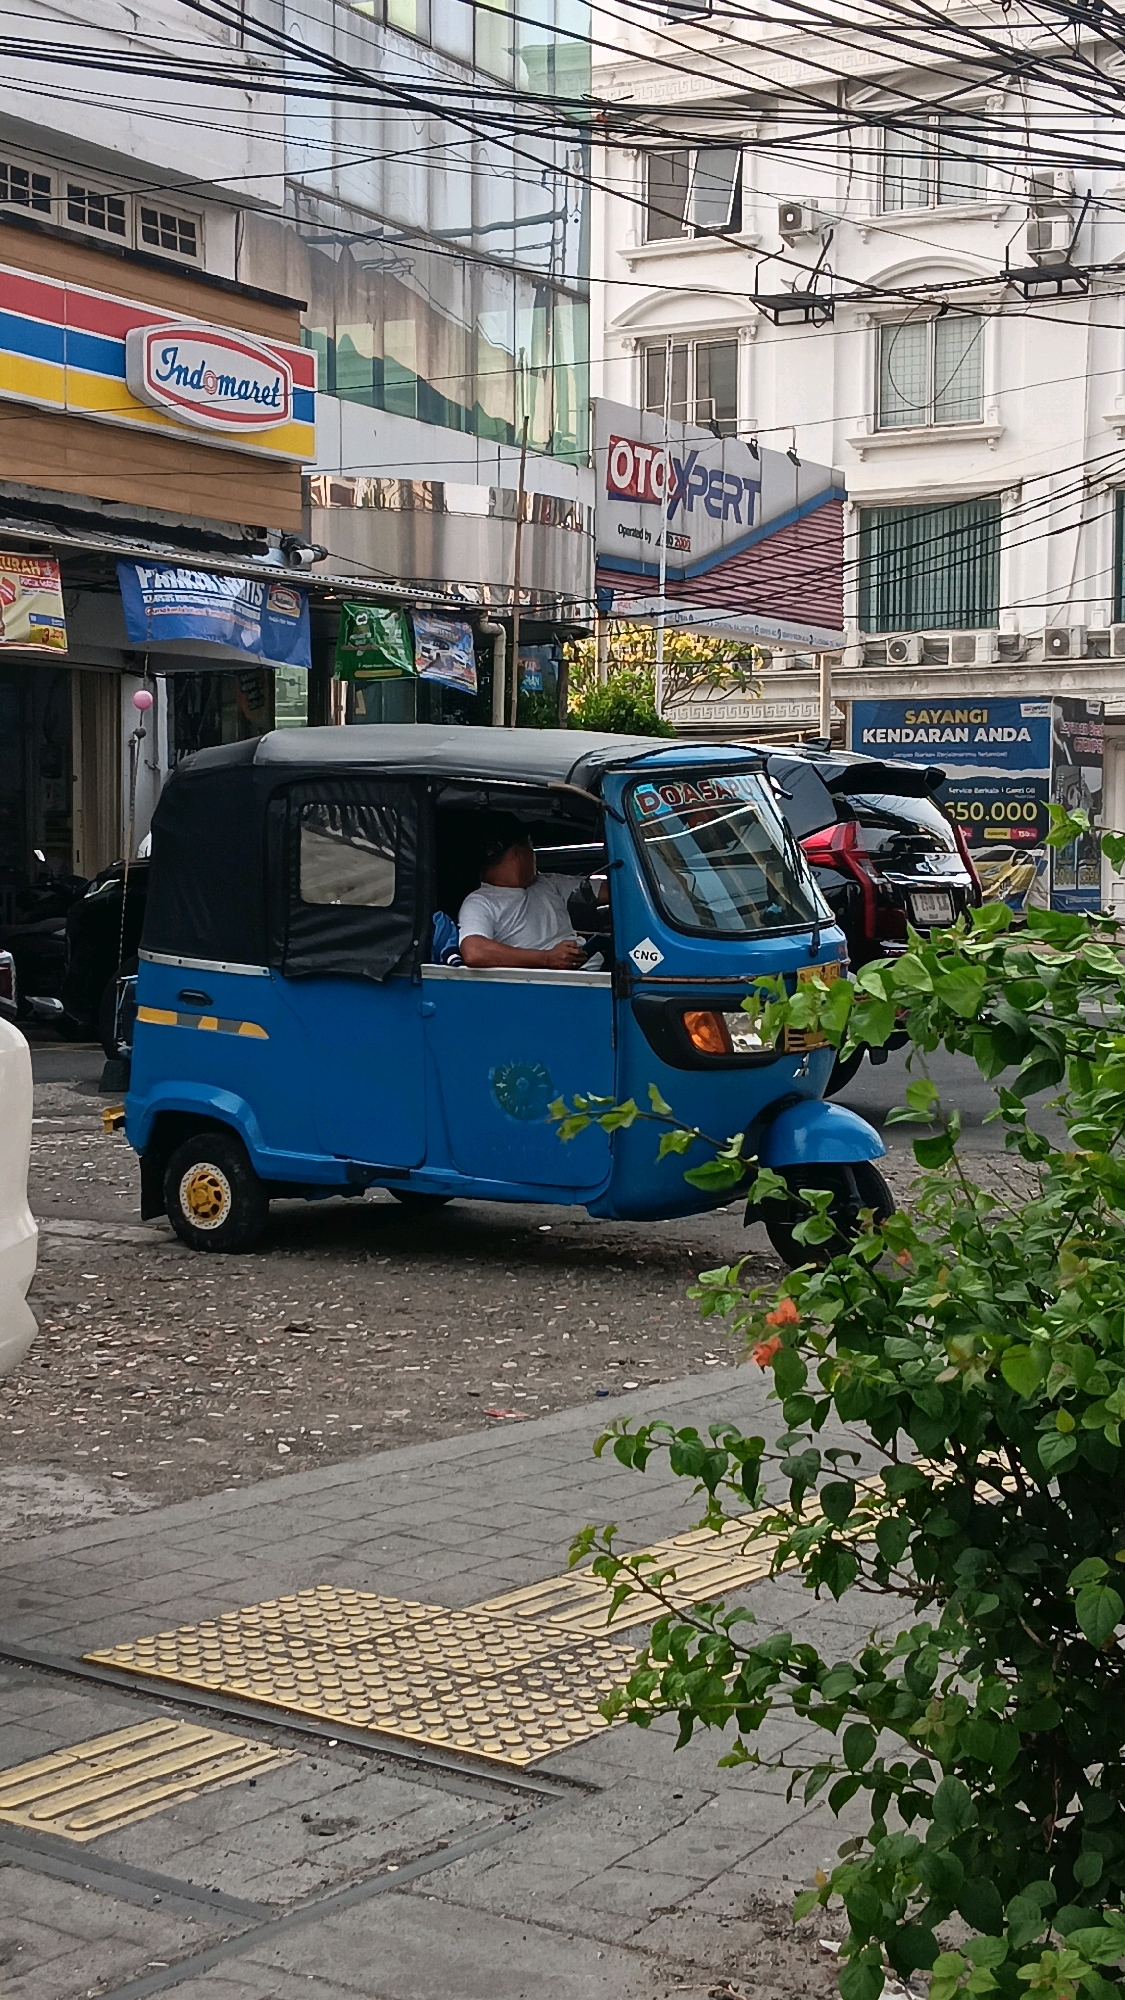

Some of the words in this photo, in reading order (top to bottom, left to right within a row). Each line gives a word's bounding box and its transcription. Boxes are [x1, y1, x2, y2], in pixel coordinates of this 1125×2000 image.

[155, 346, 282, 409] Indomaret
[905, 709, 988, 725] SAYANGI
[862, 728, 969, 743] KENDARAN
[974, 727, 1031, 743] ANDA
[633, 949, 659, 962] CNG
